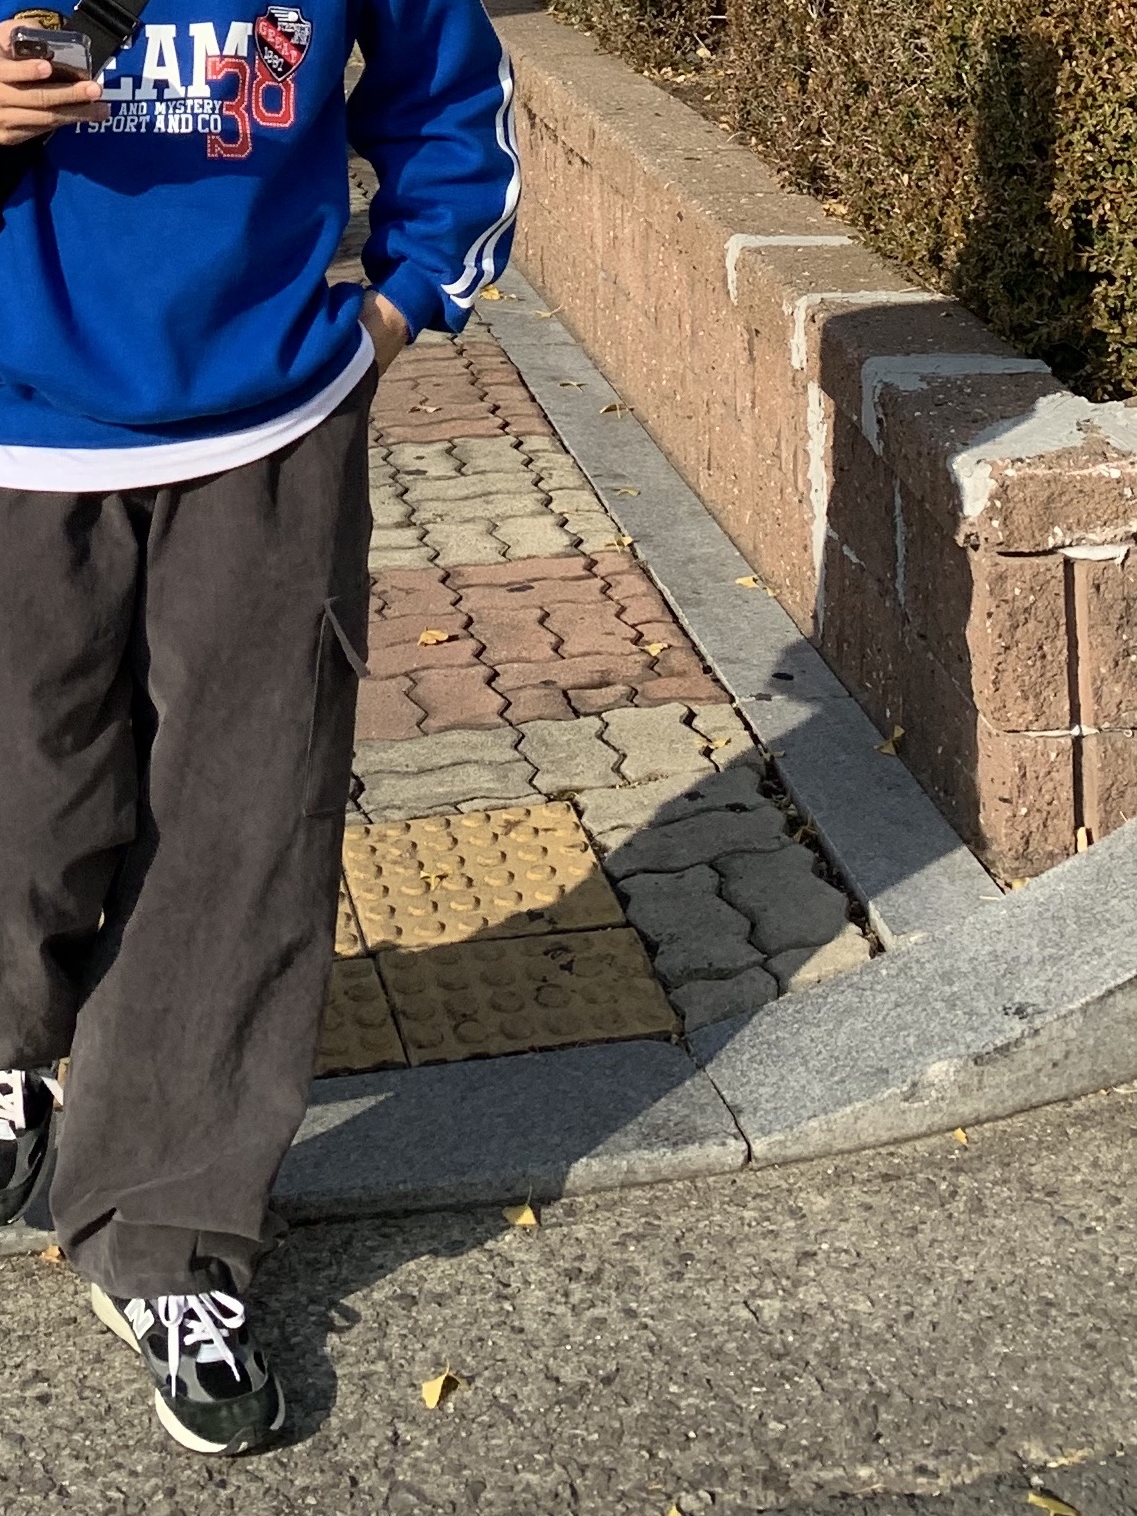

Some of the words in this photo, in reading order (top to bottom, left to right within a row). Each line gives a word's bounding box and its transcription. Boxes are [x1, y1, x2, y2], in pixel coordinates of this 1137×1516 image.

[96, 21, 254, 101] EAM
[258, 21, 298, 65] GREAT
[88, 115, 151, 134] SPORT
[153, 114, 193, 134] AND
[197, 114, 222, 134] CO
[119, 102, 147, 115] AND
[154, 99, 223, 115] MYSTERY
[206, 54, 295, 160] 38
